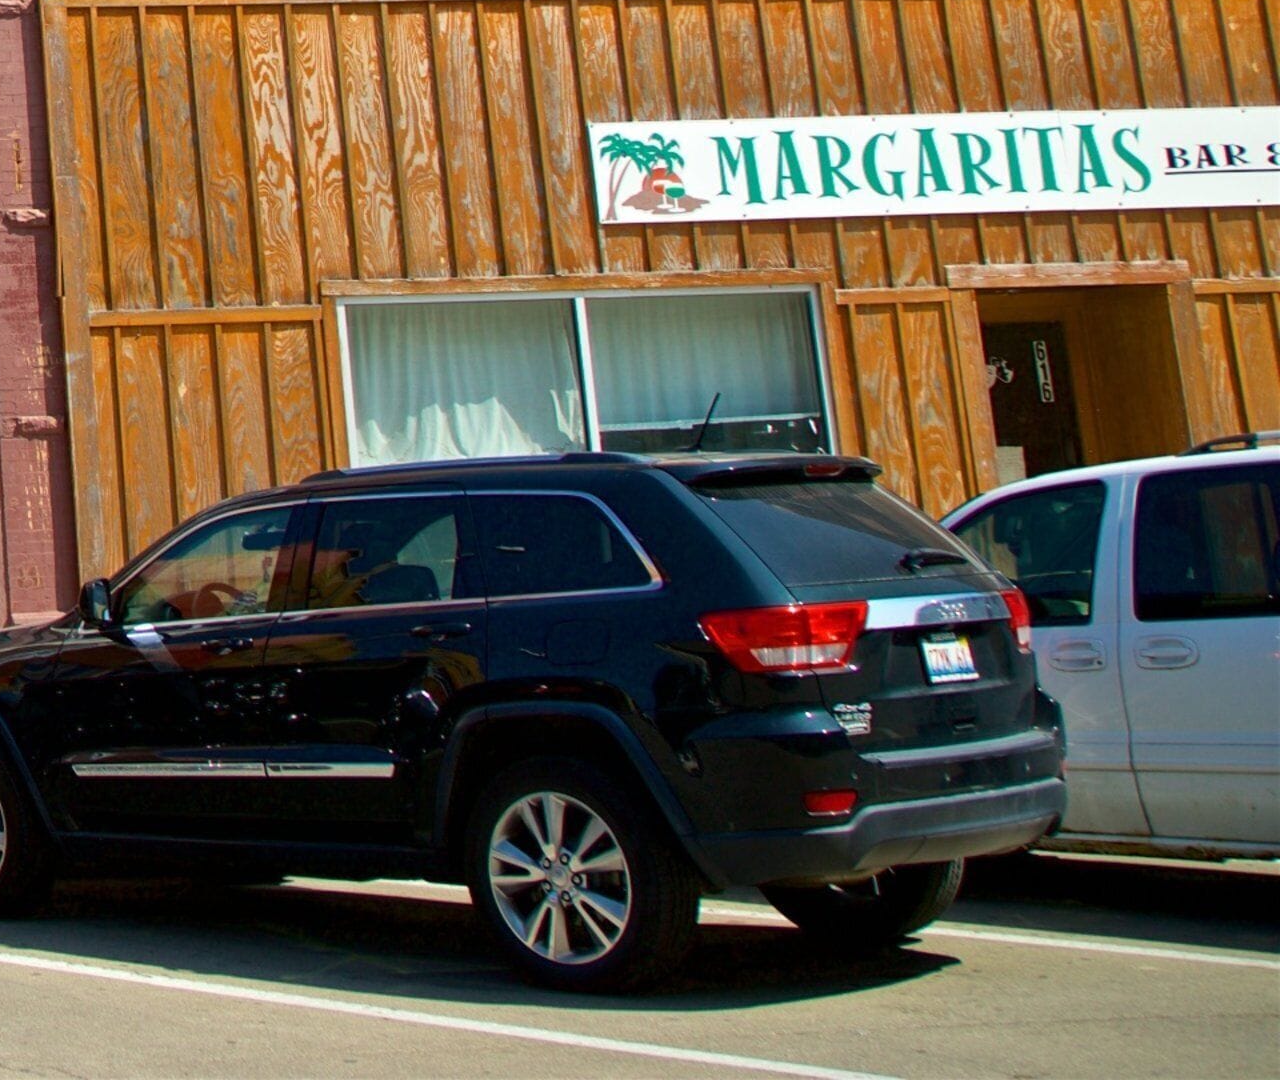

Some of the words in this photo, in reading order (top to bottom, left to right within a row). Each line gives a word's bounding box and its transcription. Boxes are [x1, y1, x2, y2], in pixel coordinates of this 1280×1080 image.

[709, 124, 1152, 205] MARGARITAS
[1165, 144, 1251, 169] BAR
[1036, 342, 1052, 401] 616
